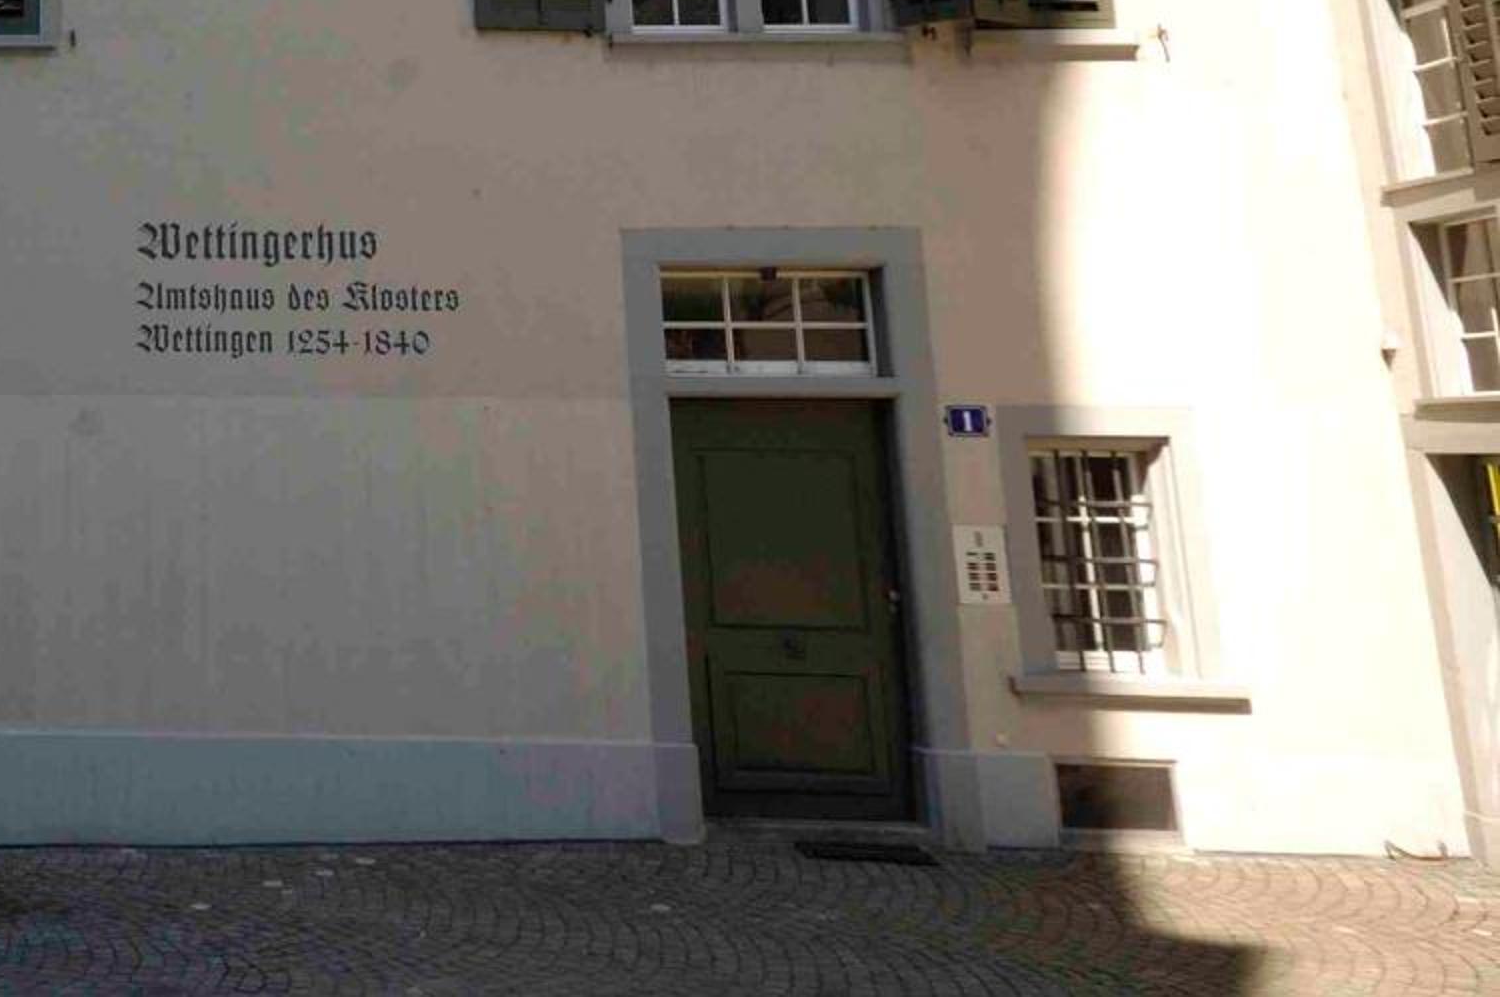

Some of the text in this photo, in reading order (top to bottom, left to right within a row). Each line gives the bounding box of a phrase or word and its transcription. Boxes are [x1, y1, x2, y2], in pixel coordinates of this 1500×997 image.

[137, 223, 378, 267] Wettingerhus
[137, 281, 460, 314] Amtshaus des Klosters
[137, 323, 273, 358] Wettingen
[962, 411, 973, 432] 1
